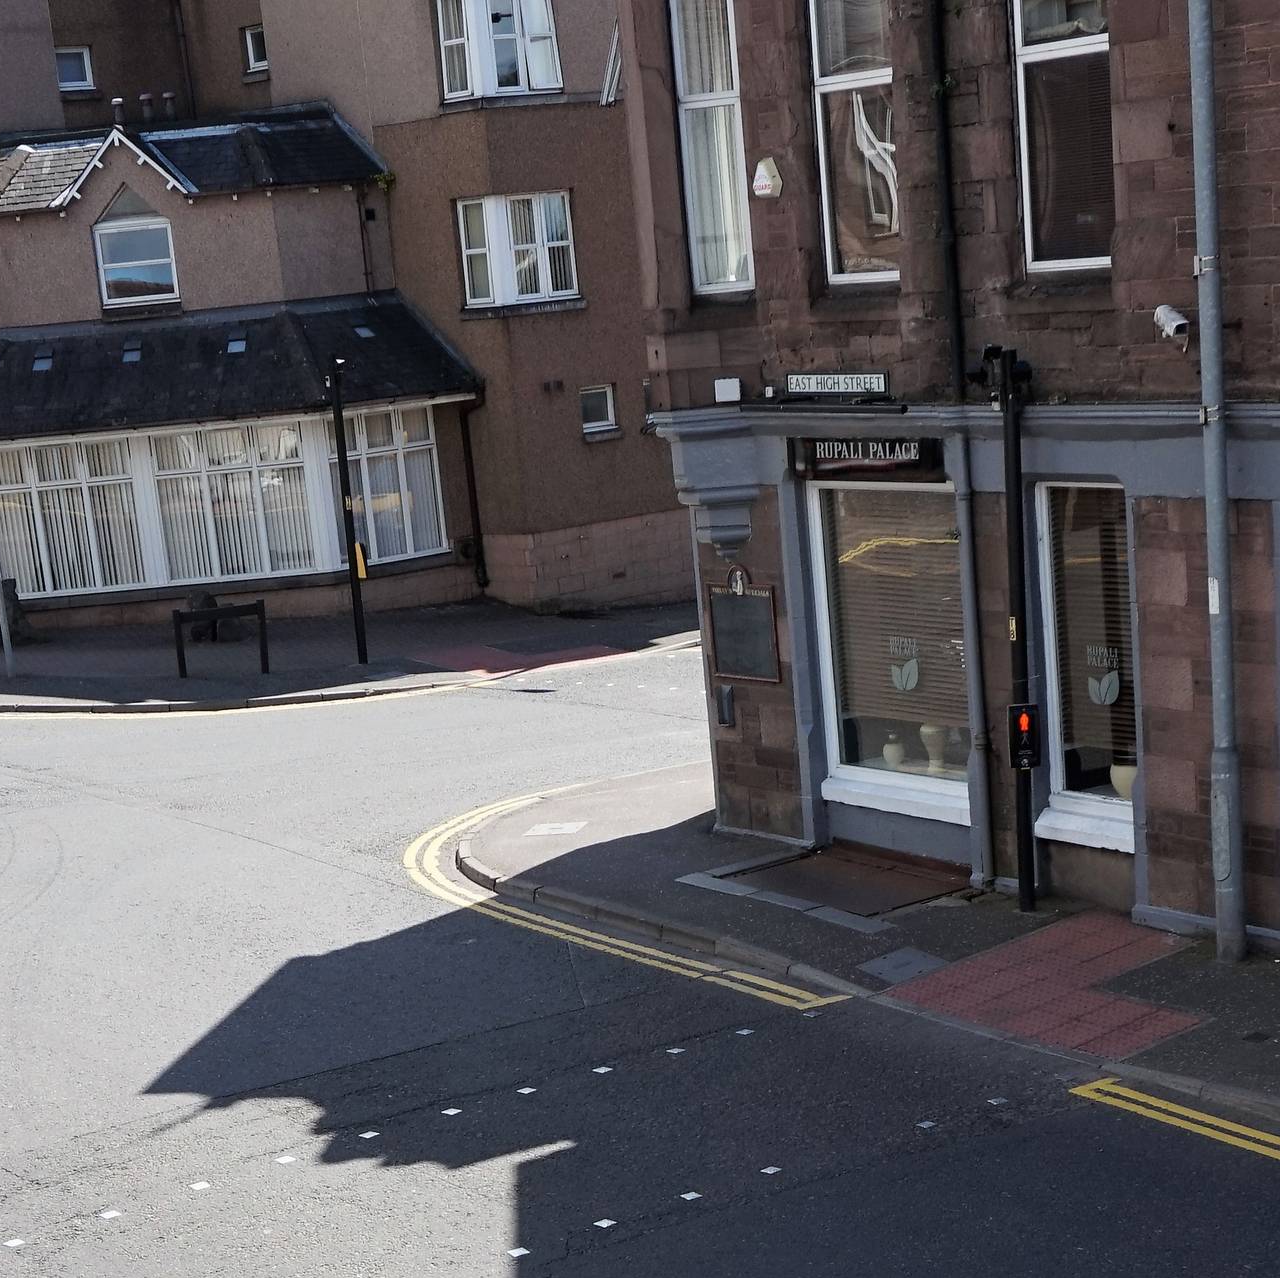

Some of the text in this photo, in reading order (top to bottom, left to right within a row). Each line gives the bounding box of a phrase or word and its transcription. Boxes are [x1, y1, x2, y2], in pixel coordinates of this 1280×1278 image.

[789, 376, 882, 391] EAST HIGH STREET
[816, 442, 919, 460] RUPALI PALACE
[1086, 645, 1118, 658] RUPALI
[1087, 656, 1119, 669] PALACE
